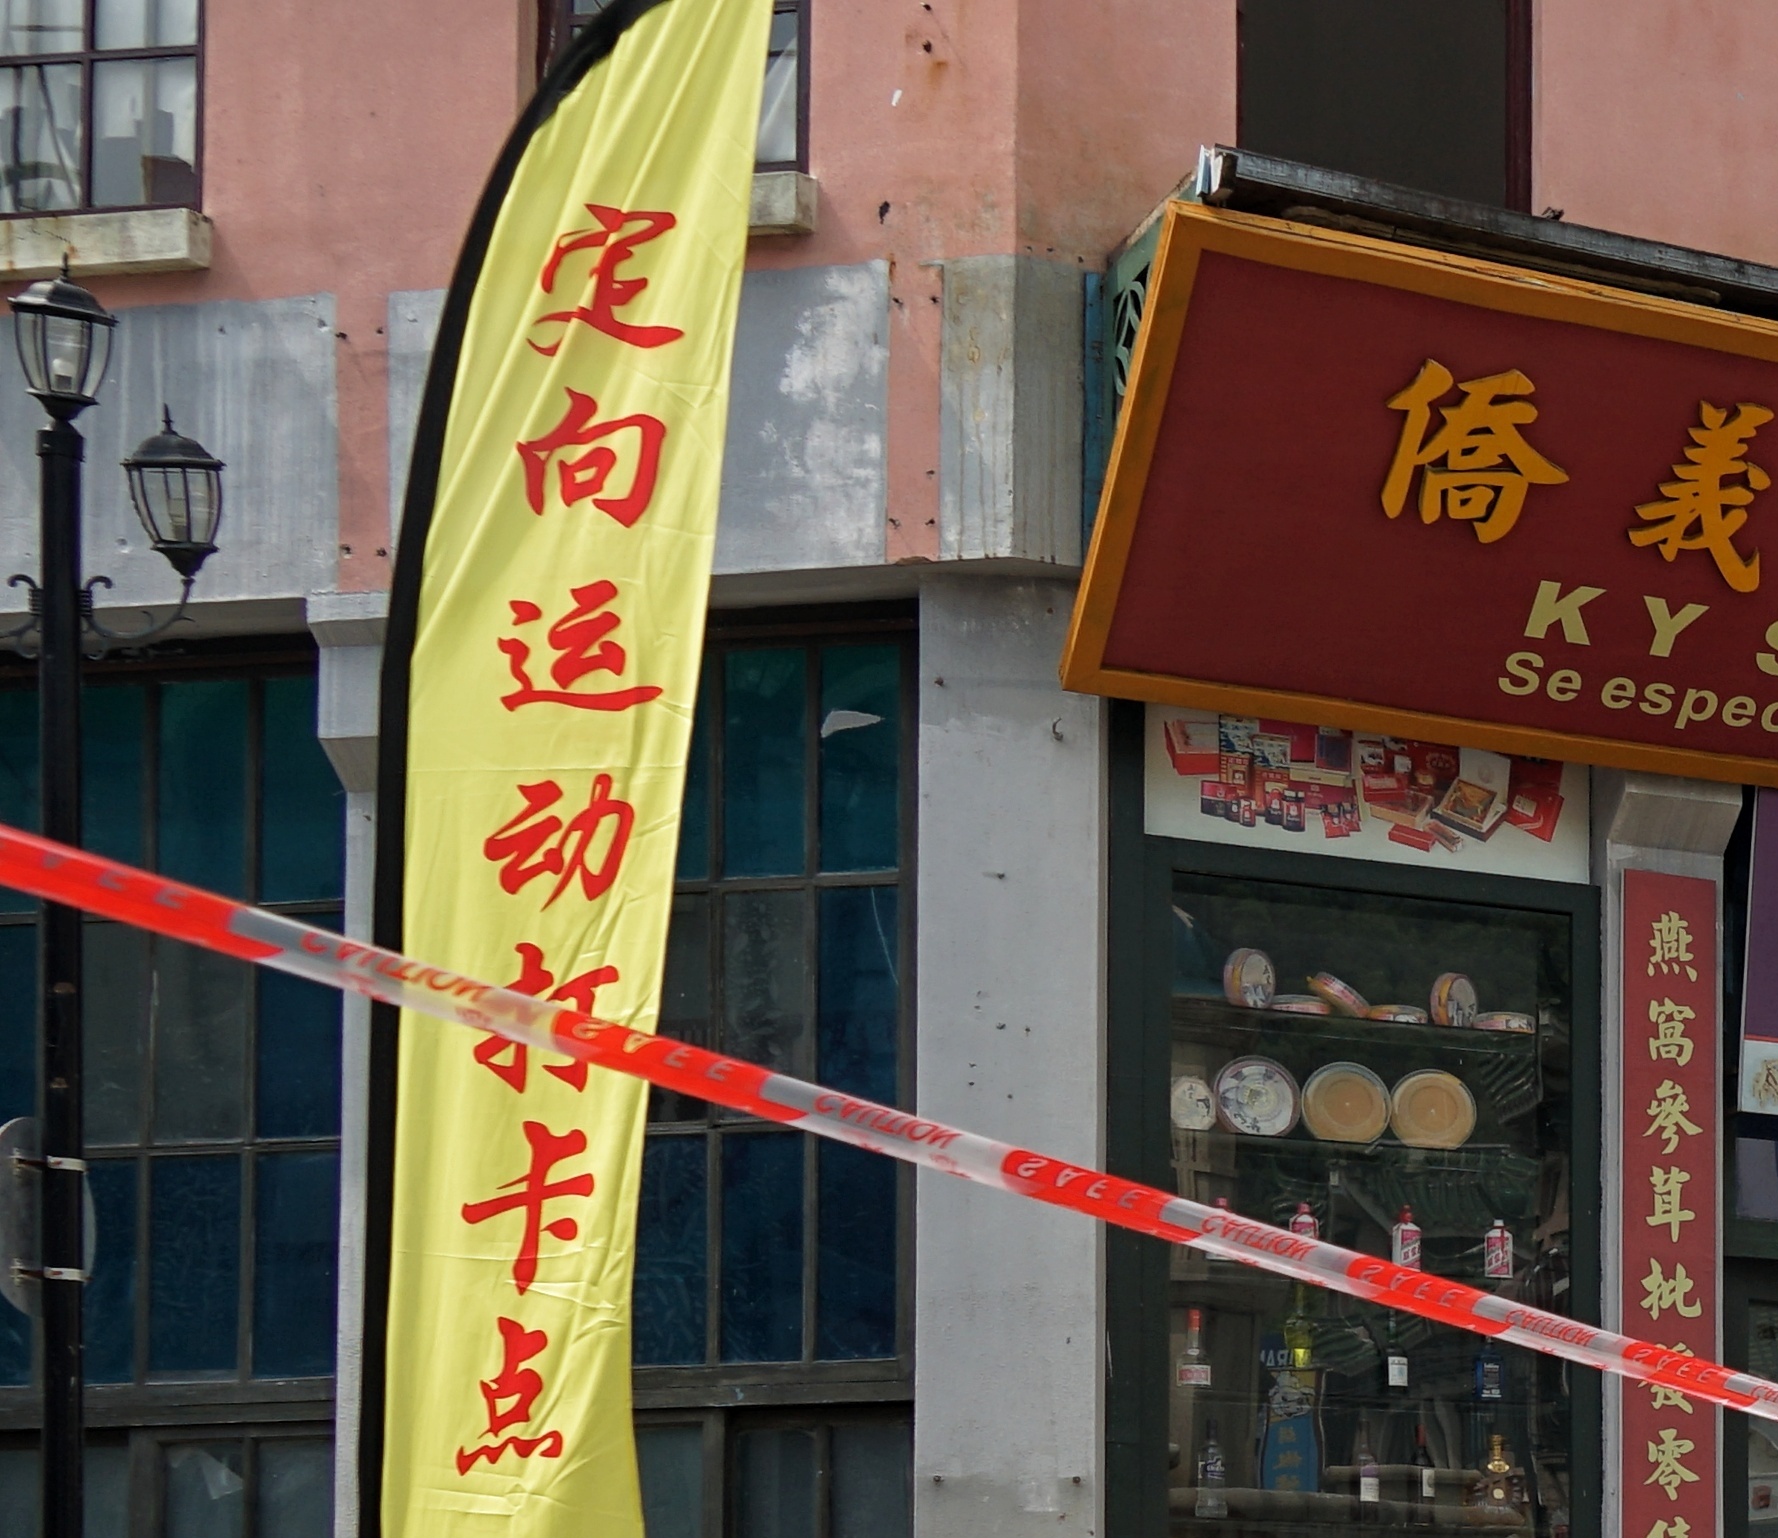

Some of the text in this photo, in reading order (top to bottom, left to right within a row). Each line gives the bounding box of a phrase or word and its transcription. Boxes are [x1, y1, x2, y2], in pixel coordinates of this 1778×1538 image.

[455, 202, 684, 1477] 定向运动打卡点
[1498, 651, 1581, 702] Se
